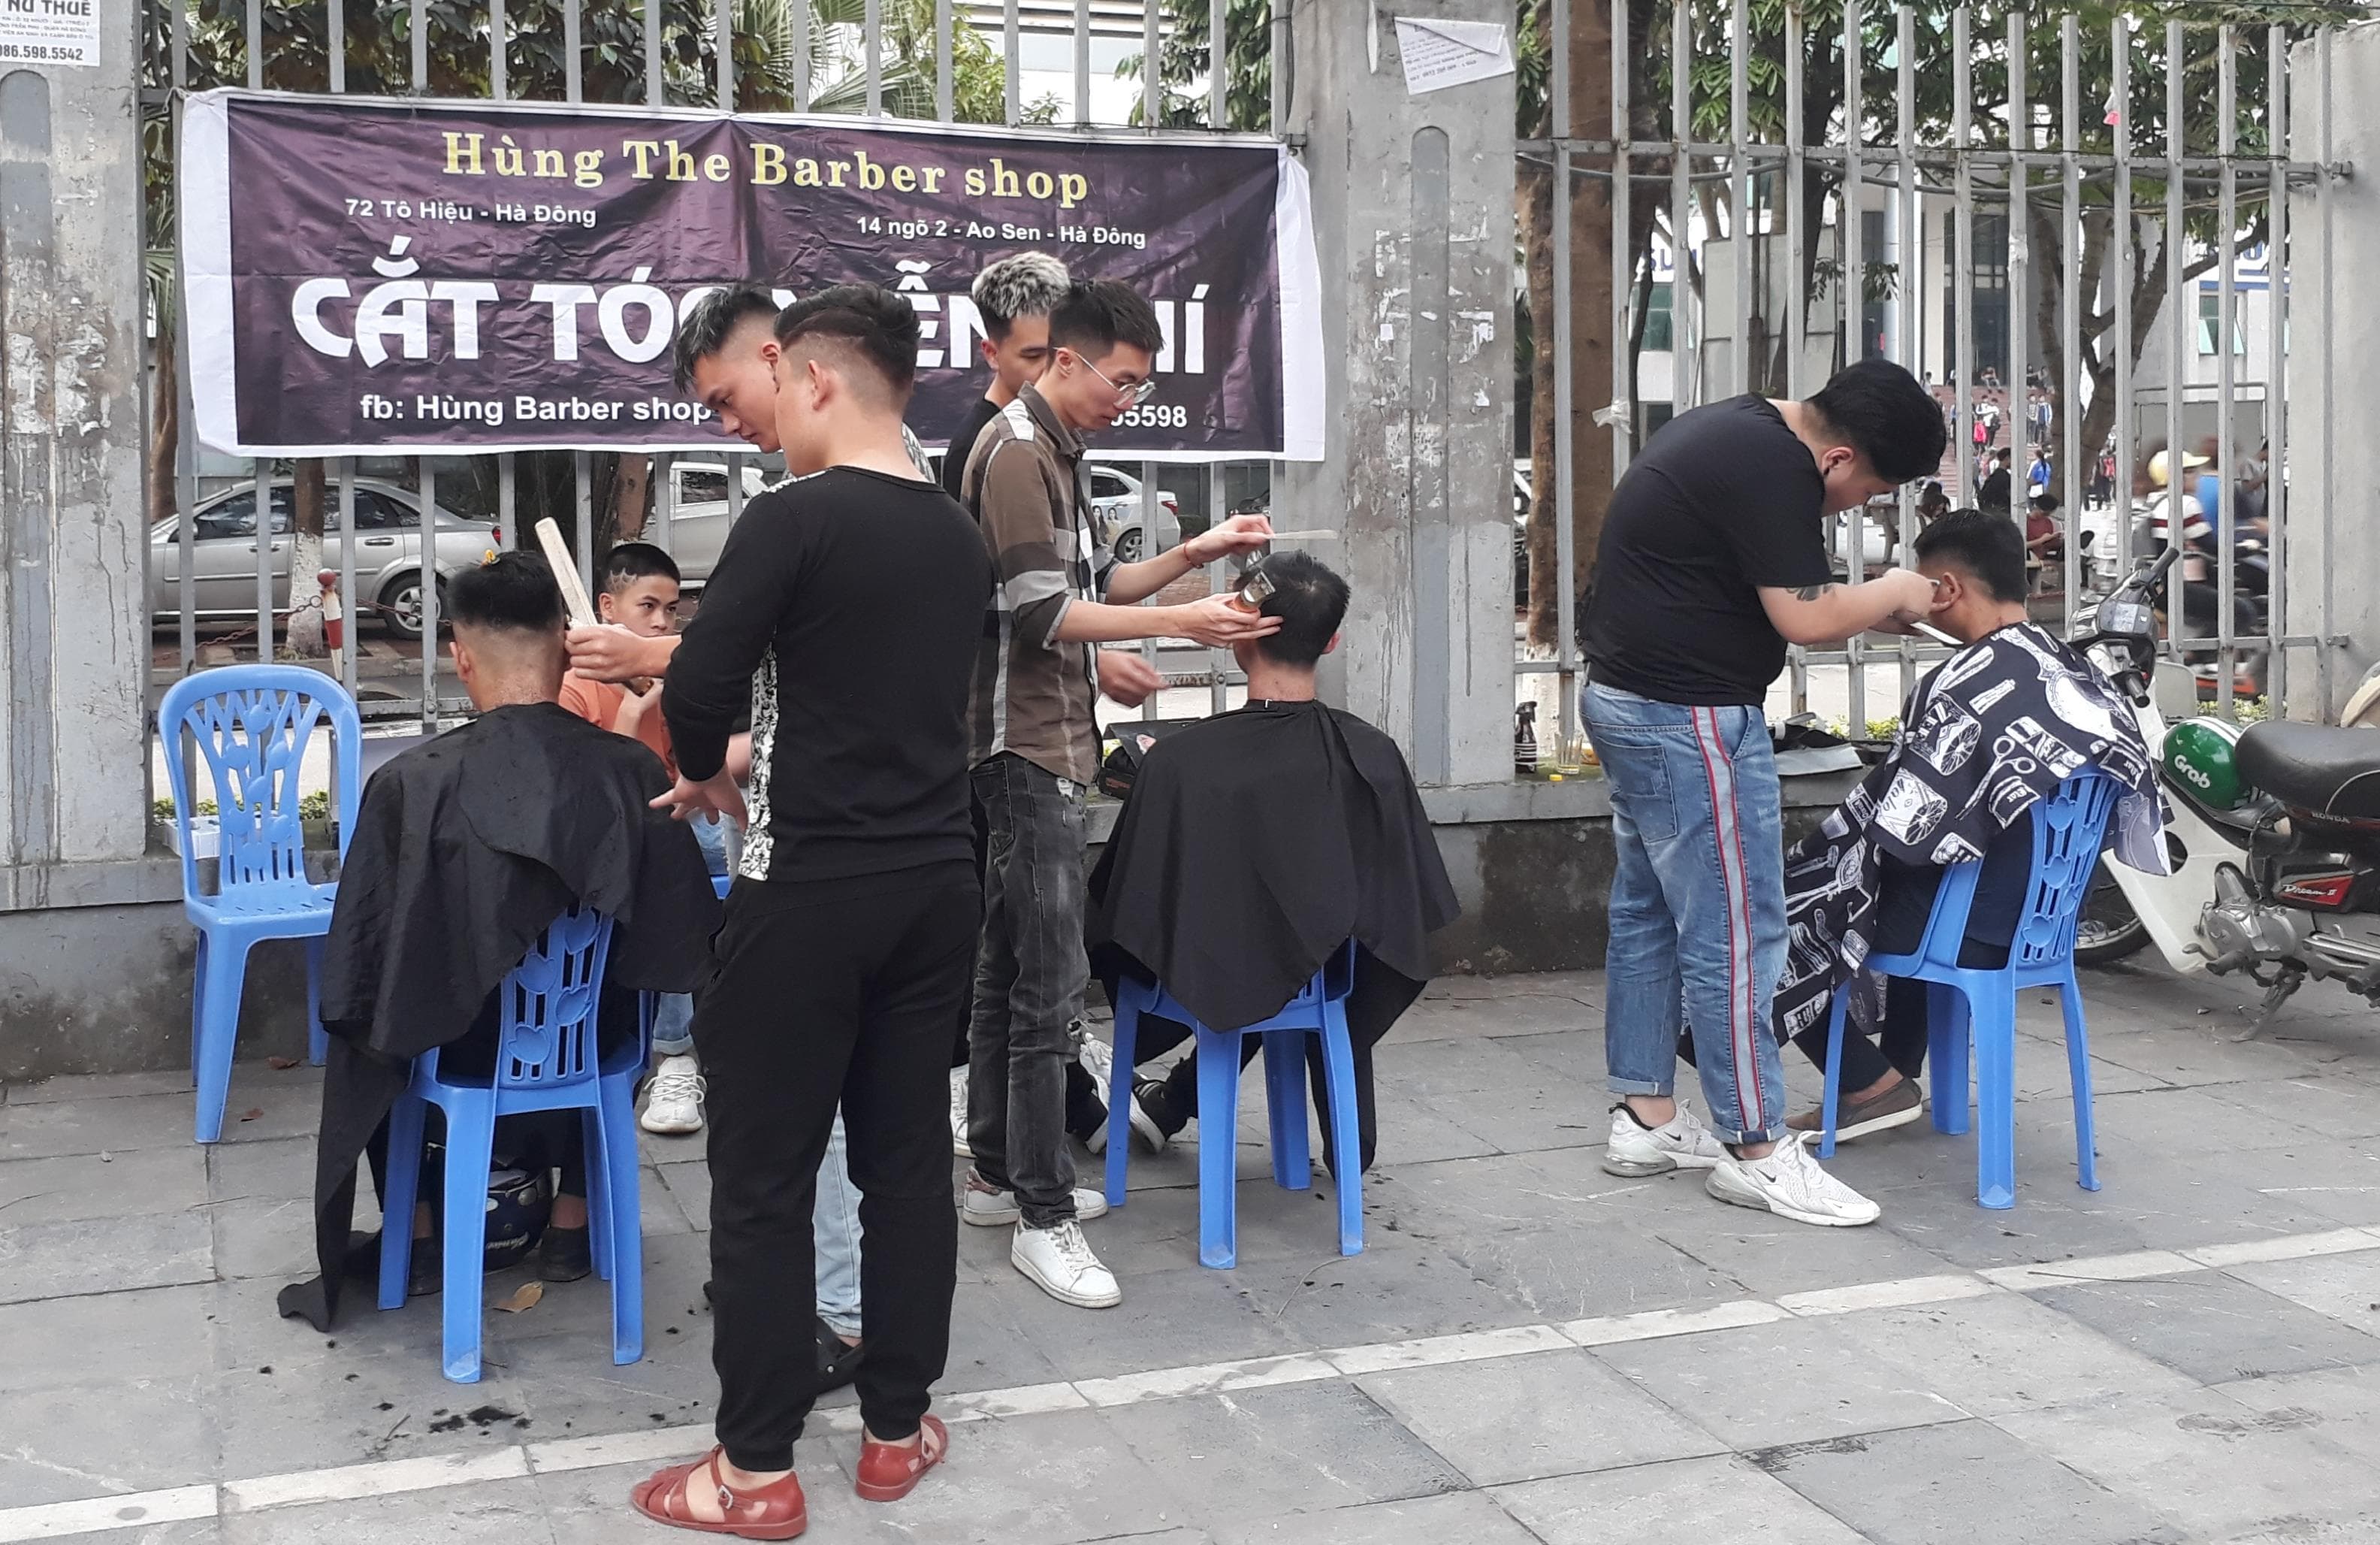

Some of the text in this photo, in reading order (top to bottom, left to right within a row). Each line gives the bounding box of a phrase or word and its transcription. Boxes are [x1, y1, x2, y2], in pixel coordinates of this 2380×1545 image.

[442, 132, 1089, 209] Hùng The Barber shop
[345, 198, 374, 217] 72
[381, 199, 412, 219] Tô
[419, 201, 473, 225] Hiệu
[495, 204, 527, 222] Hà
[533, 204, 597, 229] Đông
[856, 216, 881, 234] 14
[888, 219, 929, 240] ngõ
[935, 219, 947, 237] 2
[966, 222, 995, 239] Ao
[1001, 224, 1041, 240] Sen
[1060, 227, 1087, 243] Hà
[1093, 228, 1146, 249] Đông
[291, 234, 500, 369] CẮT
[360, 395, 711, 425] fb: Hùng Barber shop
[2173, 754, 2211, 788] Grab
[2282, 884, 2327, 895] Dream
